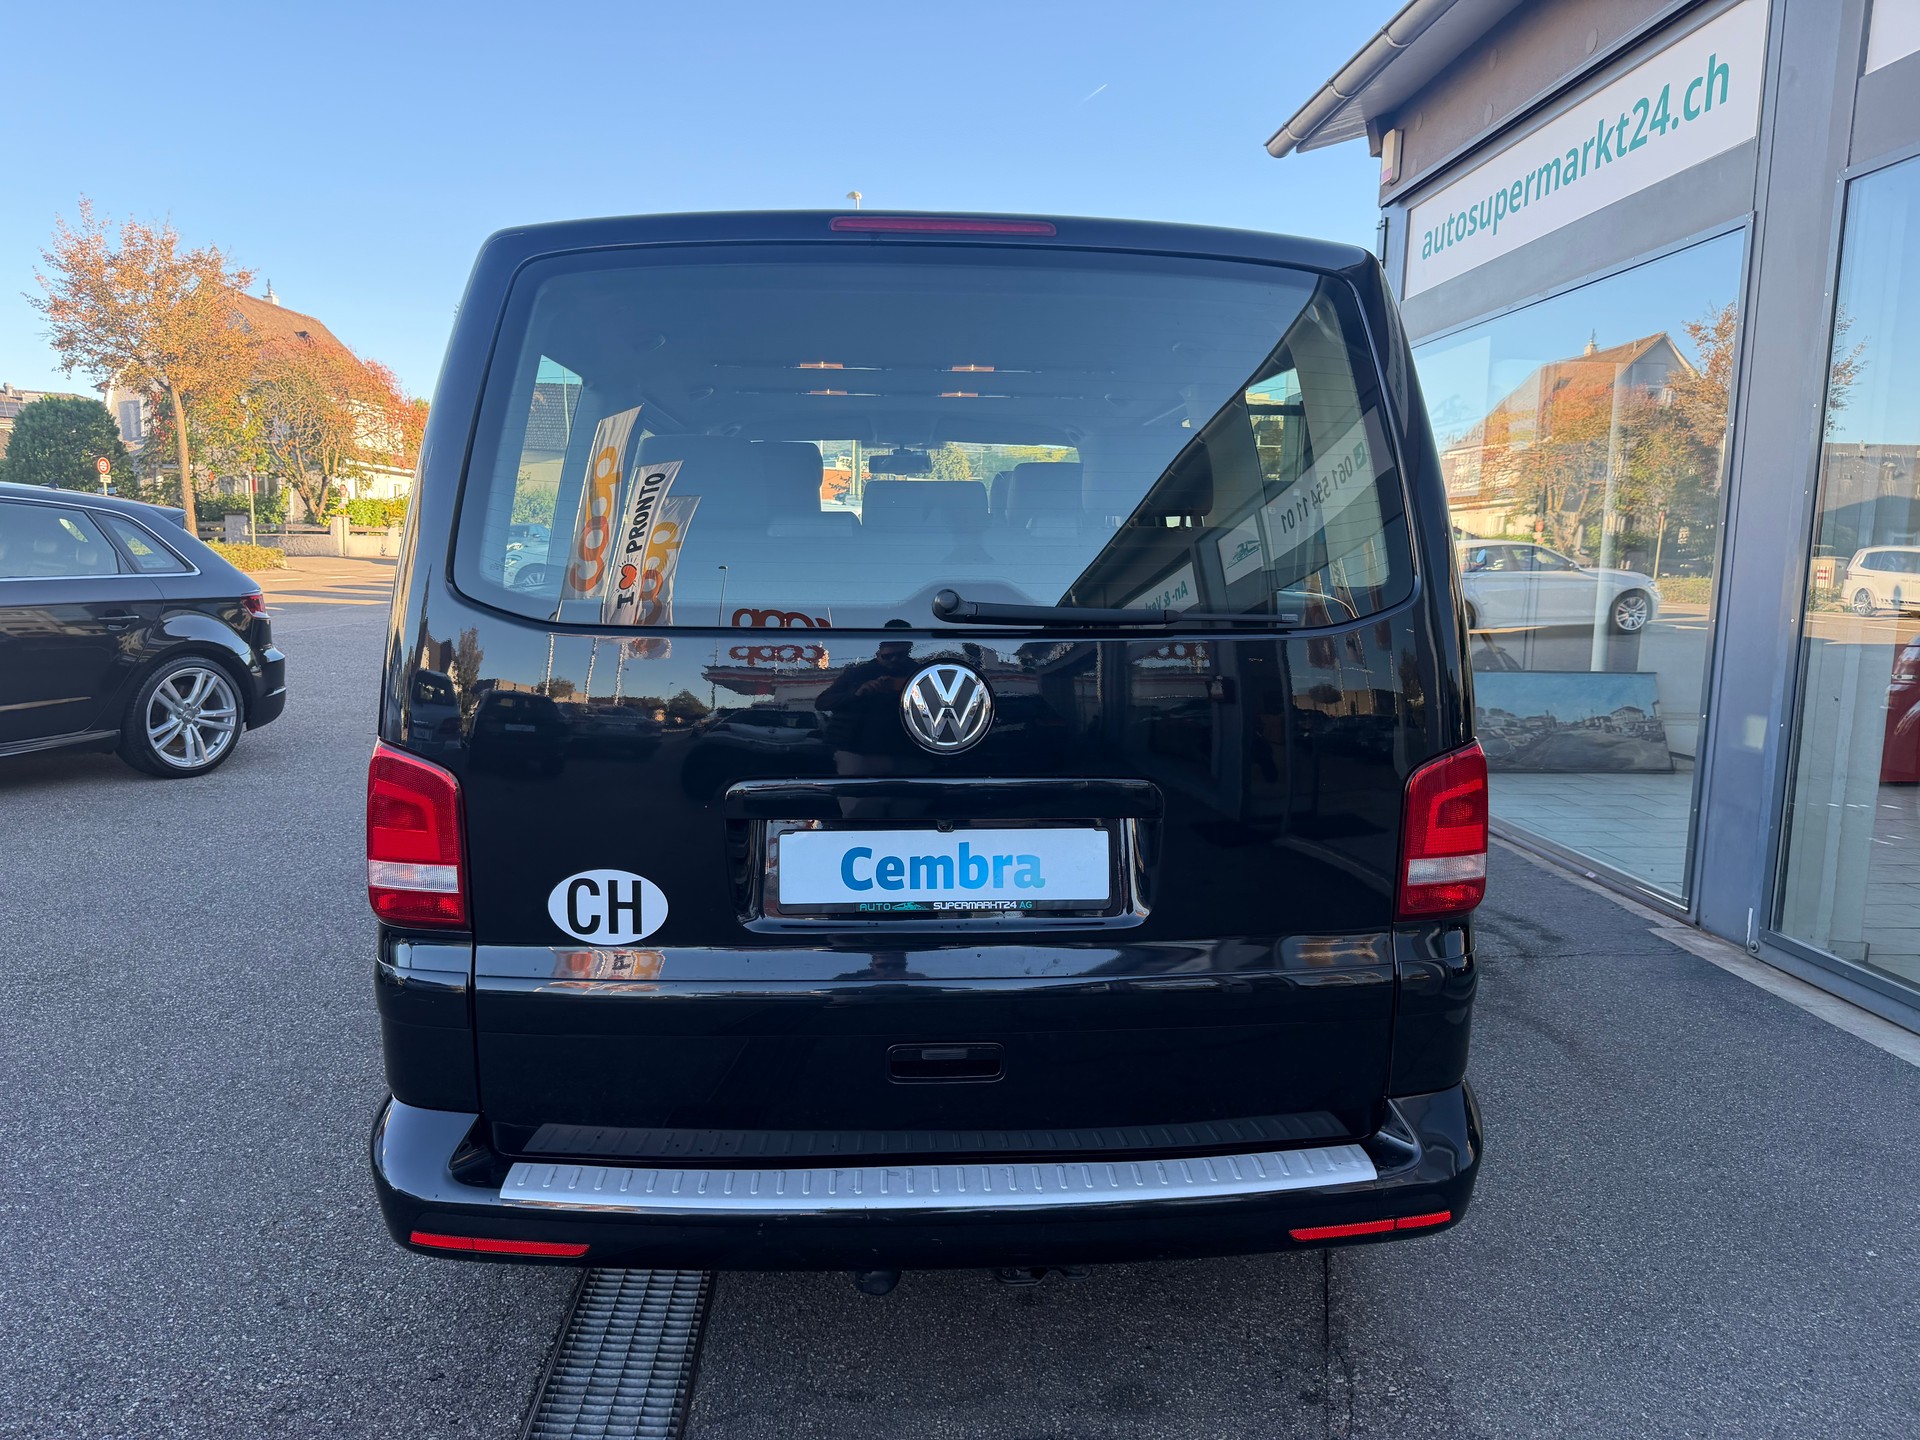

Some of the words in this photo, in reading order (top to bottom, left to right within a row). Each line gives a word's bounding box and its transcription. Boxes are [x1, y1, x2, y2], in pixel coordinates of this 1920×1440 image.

[1421, 52, 1730, 261] autosupermarkt24.ch
[626, 472, 666, 554] PRONTO
[840, 841, 1046, 891] Cembra
[567, 878, 643, 935] CH
[859, 903, 891, 912] AUTO
[933, 901, 1018, 910] SUPERMARKT24
[1019, 901, 1033, 909] AG
